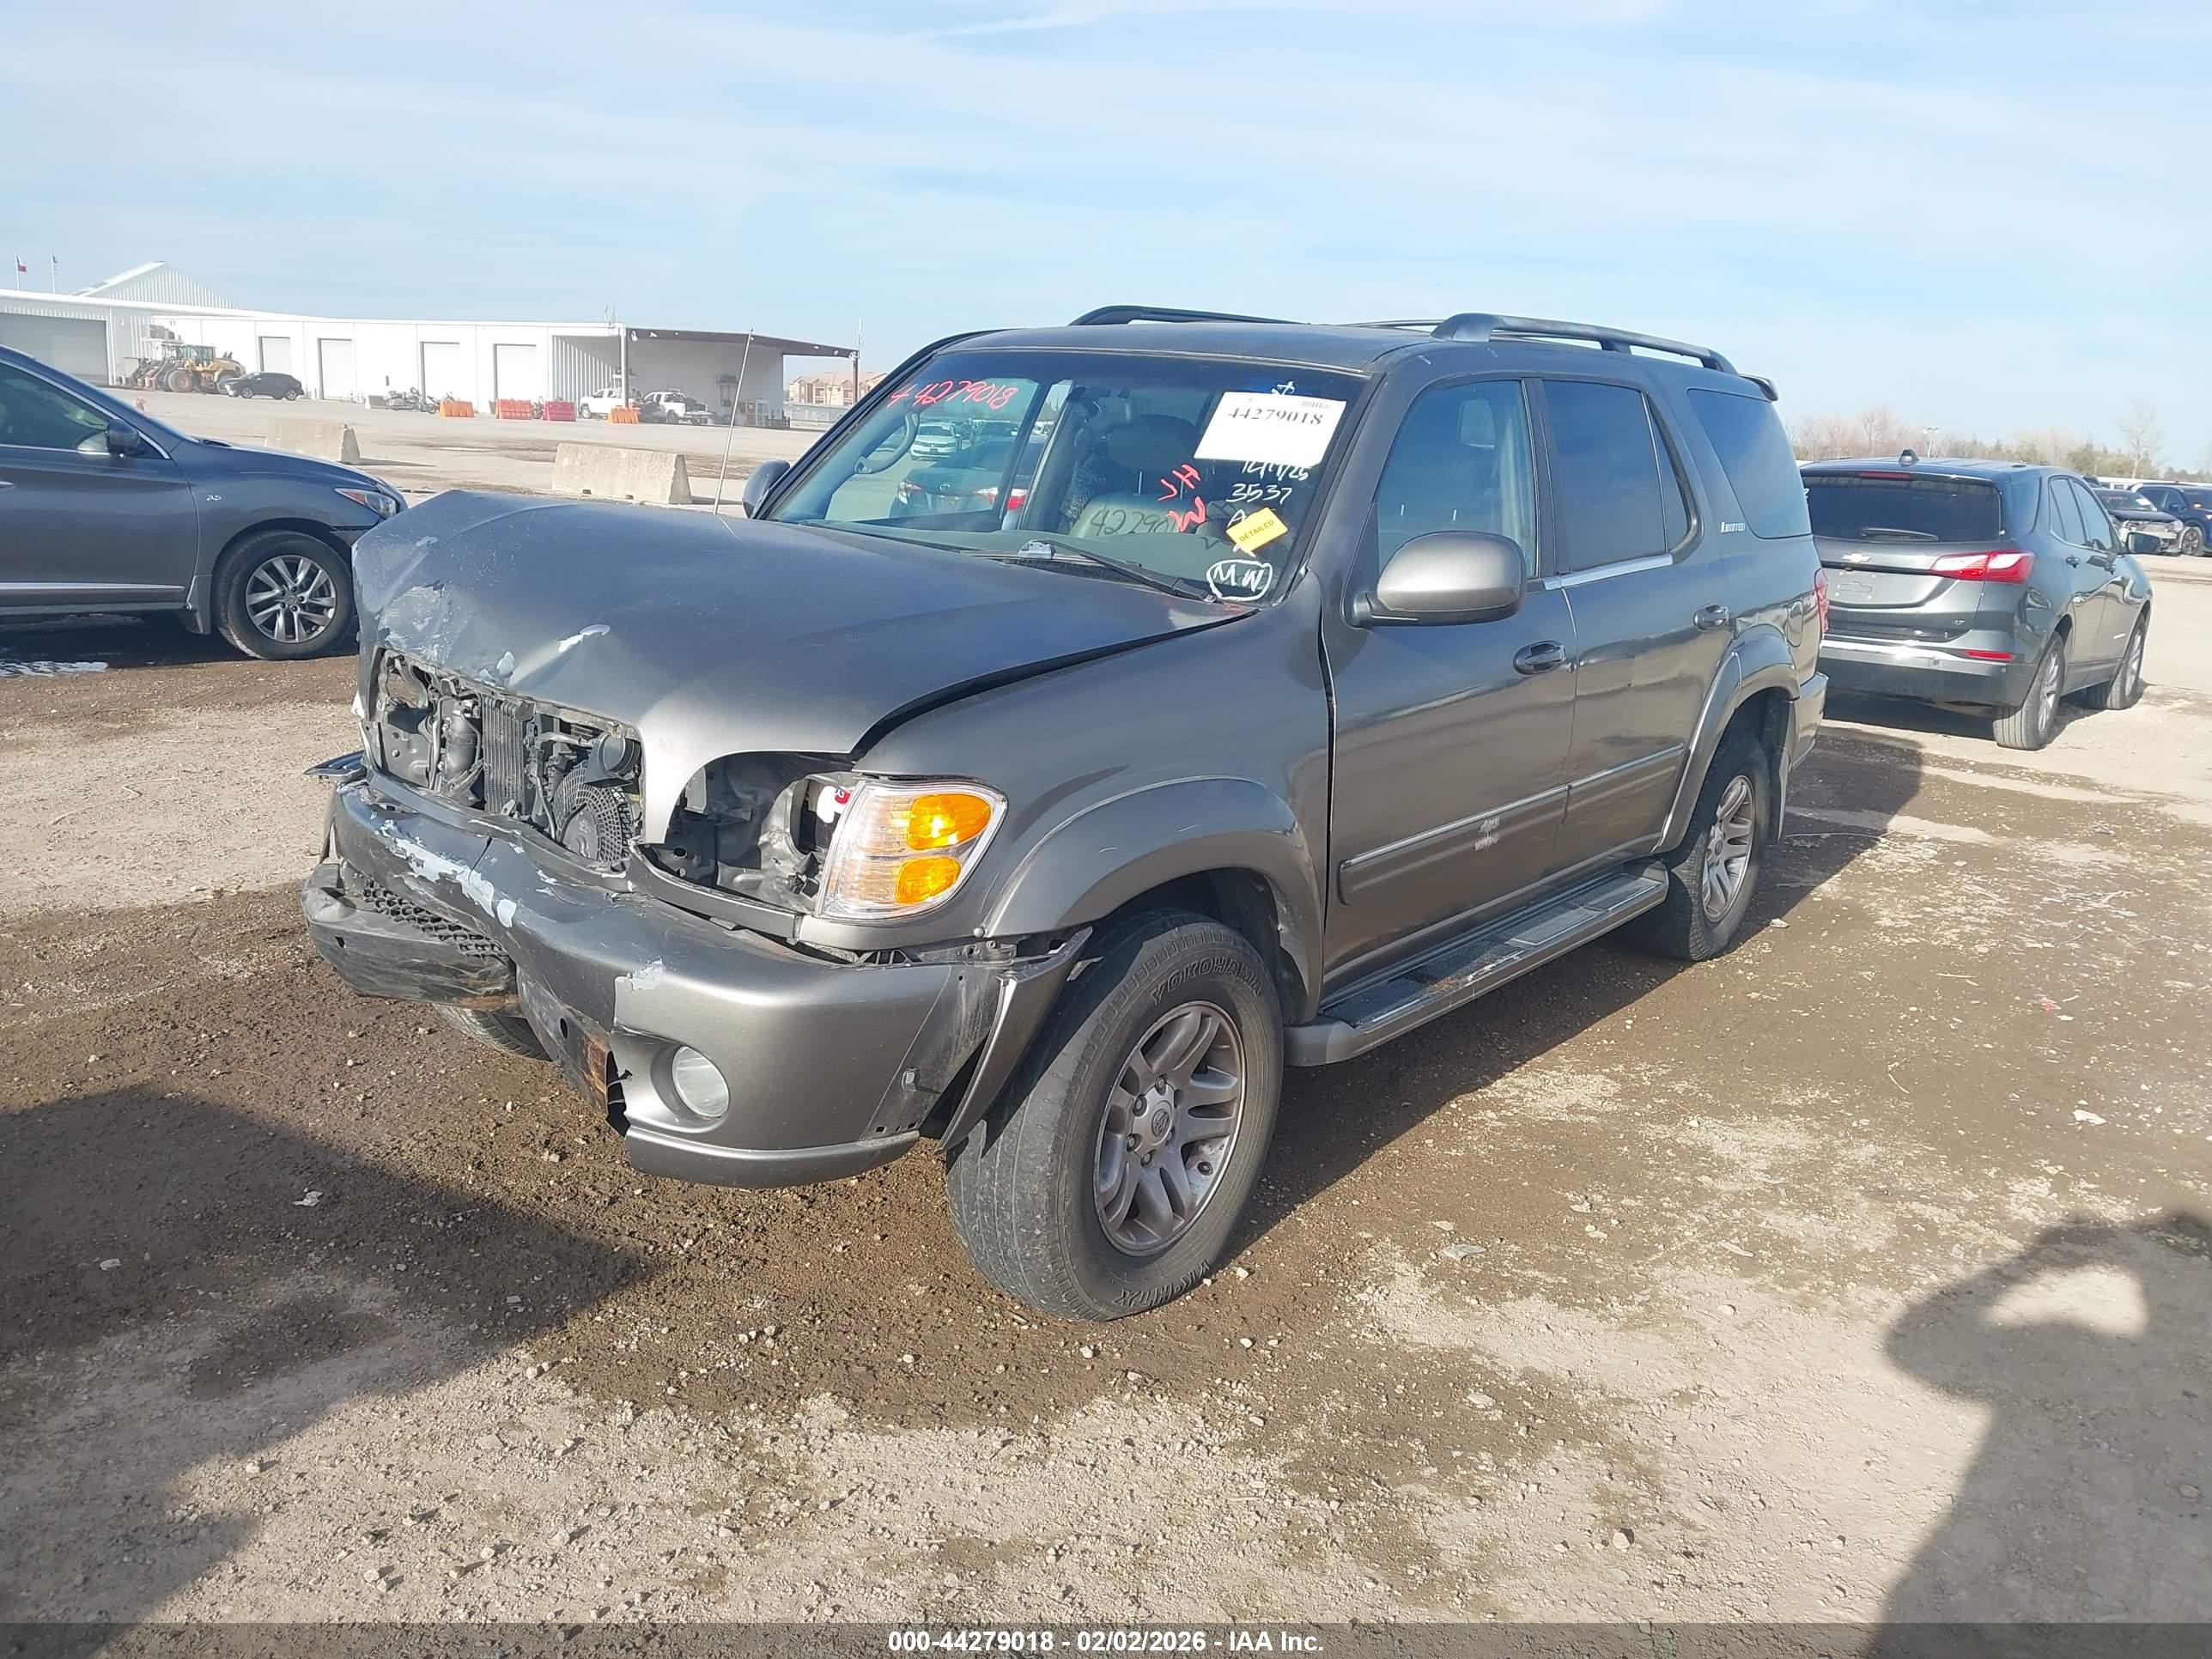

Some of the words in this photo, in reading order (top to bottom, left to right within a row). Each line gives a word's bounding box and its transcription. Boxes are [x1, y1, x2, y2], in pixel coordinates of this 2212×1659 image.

[1227, 406, 1324, 426] 44279018
[1225, 483, 1293, 505] 3537
[1239, 519, 1274, 542] DETAILED
[1150, 957, 1263, 1006] YOKOHAMA
